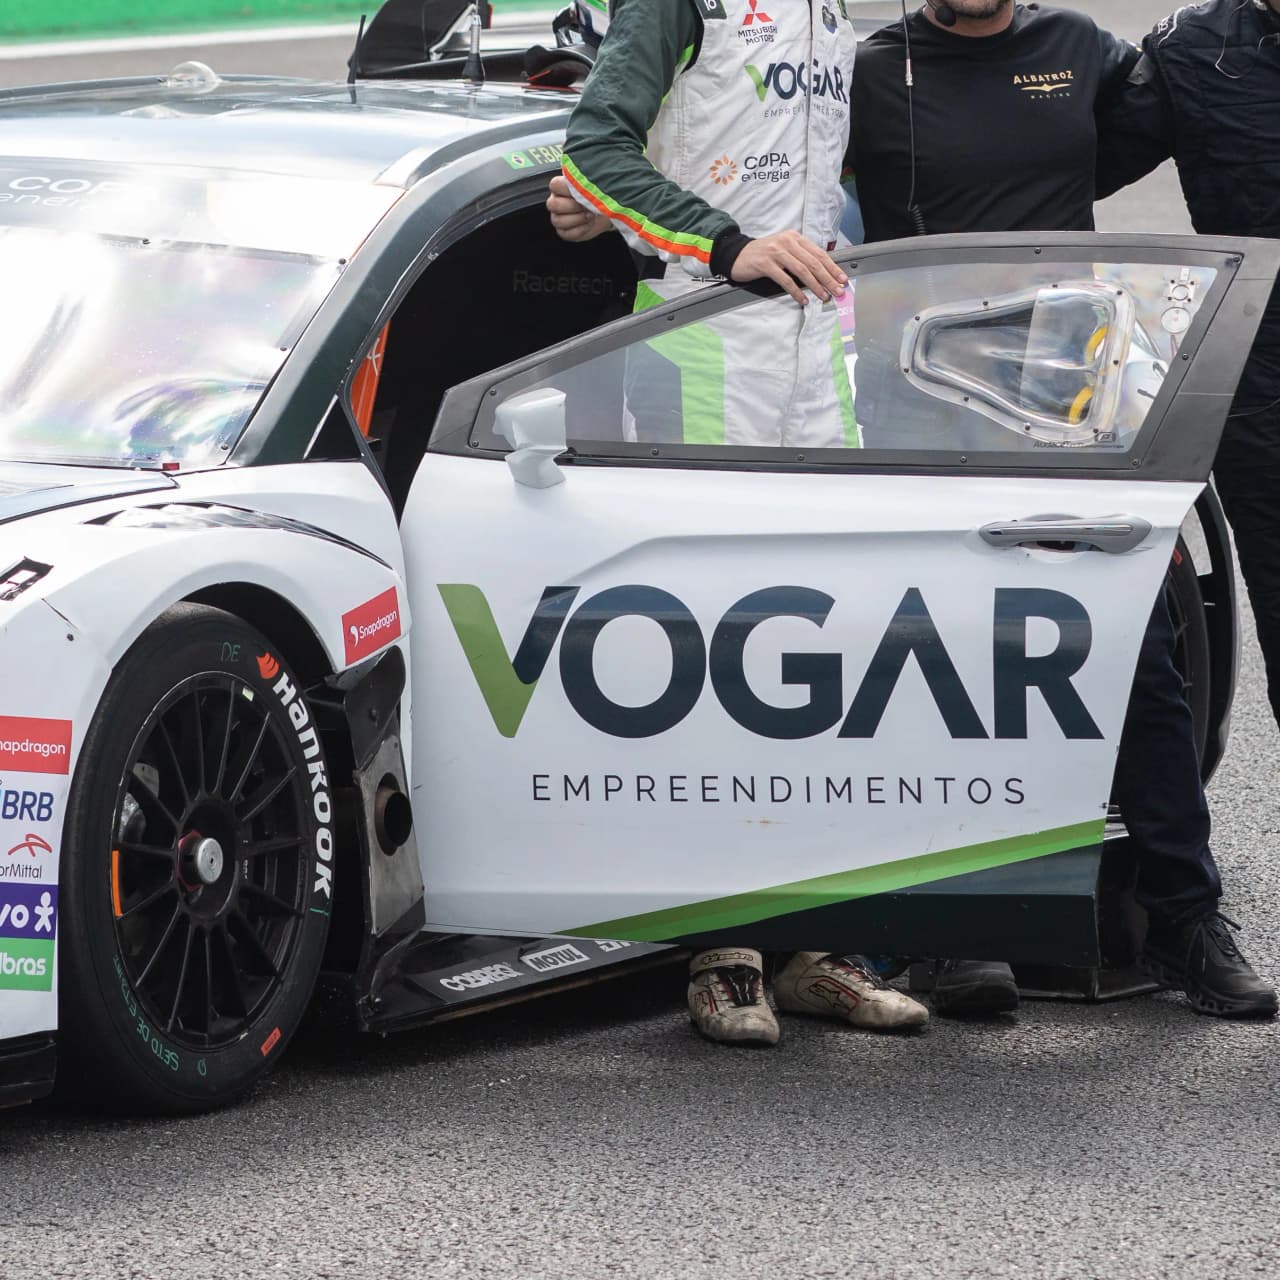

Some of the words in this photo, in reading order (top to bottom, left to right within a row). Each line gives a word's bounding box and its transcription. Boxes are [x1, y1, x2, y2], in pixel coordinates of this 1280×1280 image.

[744, 58, 848, 105] VOGAR
[1013, 70, 1074, 85] ALBATROZ
[744, 152, 790, 169] COPA
[512, 270, 614, 297] Racetech
[359, 610, 397, 639] Snapdragon
[435, 583, 1104, 740] VOGAR
[532, 773, 1026, 806] EMPREENDIMENTOS
[2, 789, 54, 822] BRB
[528, 948, 584, 970] MOTUL
